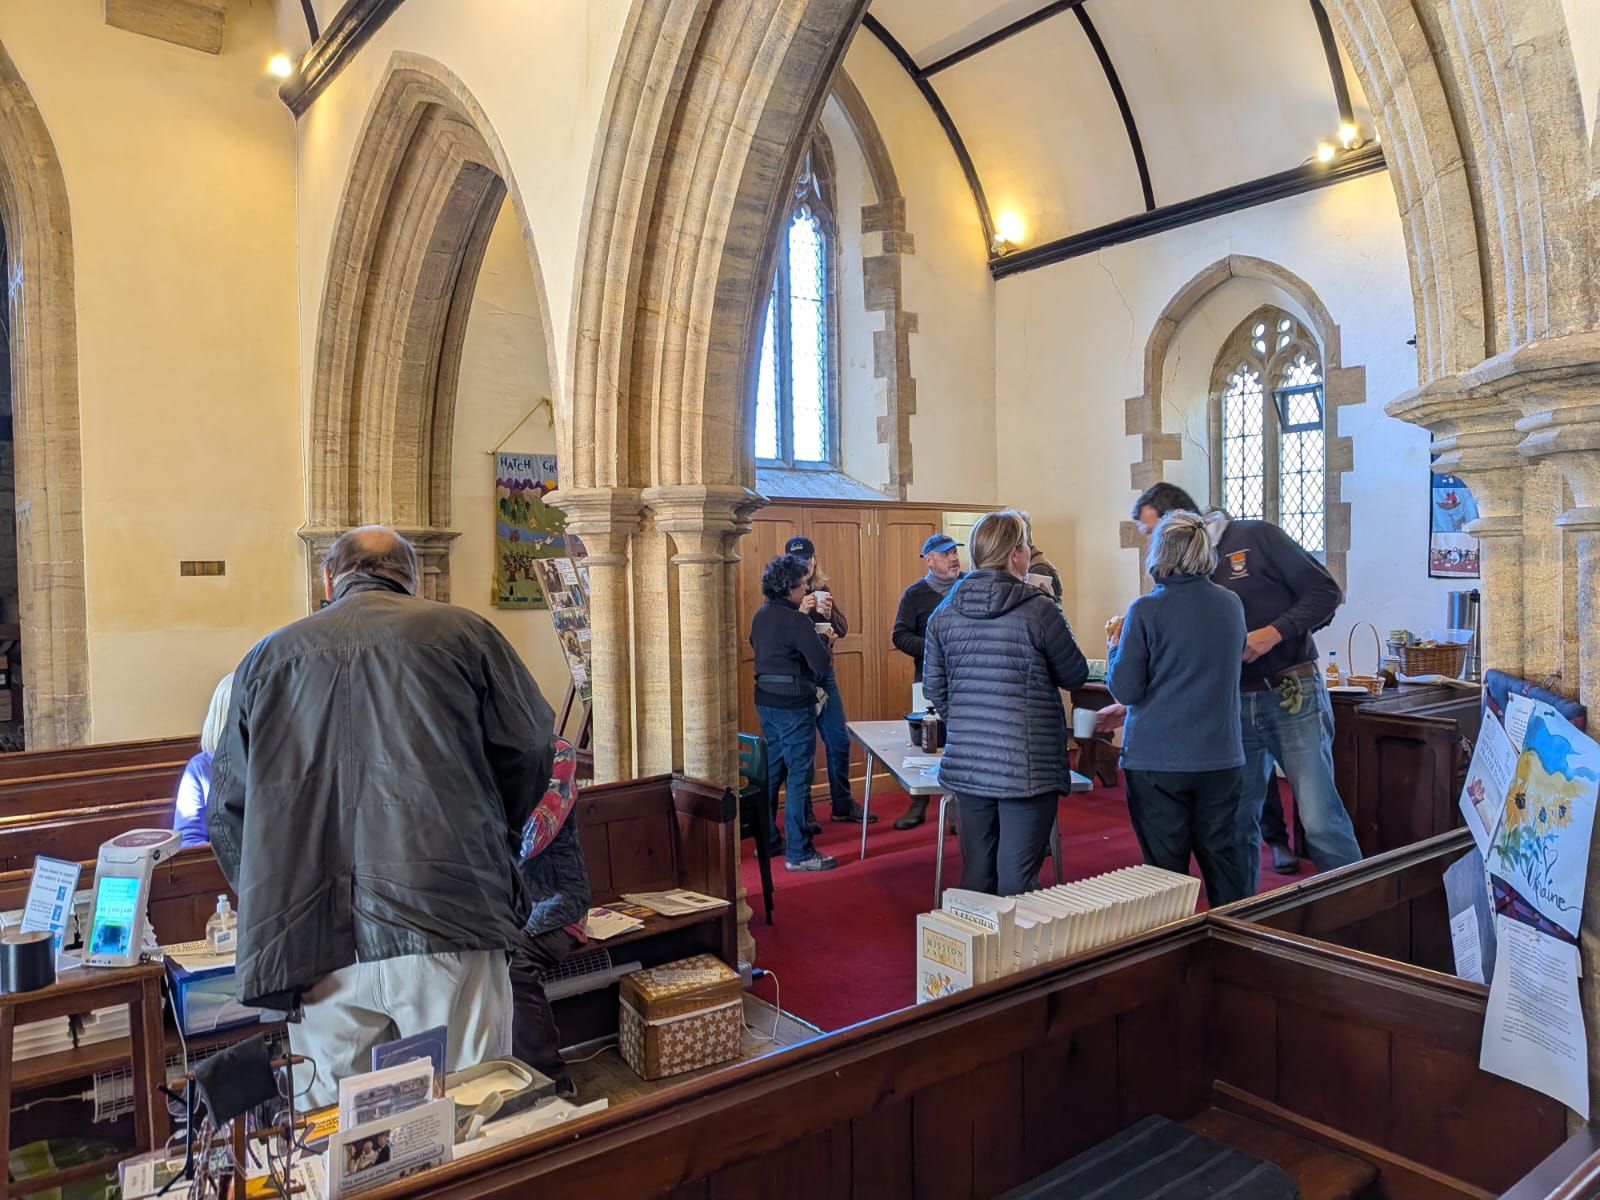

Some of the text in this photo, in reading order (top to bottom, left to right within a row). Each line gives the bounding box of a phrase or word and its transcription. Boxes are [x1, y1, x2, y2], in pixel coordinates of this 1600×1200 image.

[500, 457, 531, 472] HATCH
[1527, 859, 1581, 911] Ukraine
[926, 937, 963, 959] MISSION
